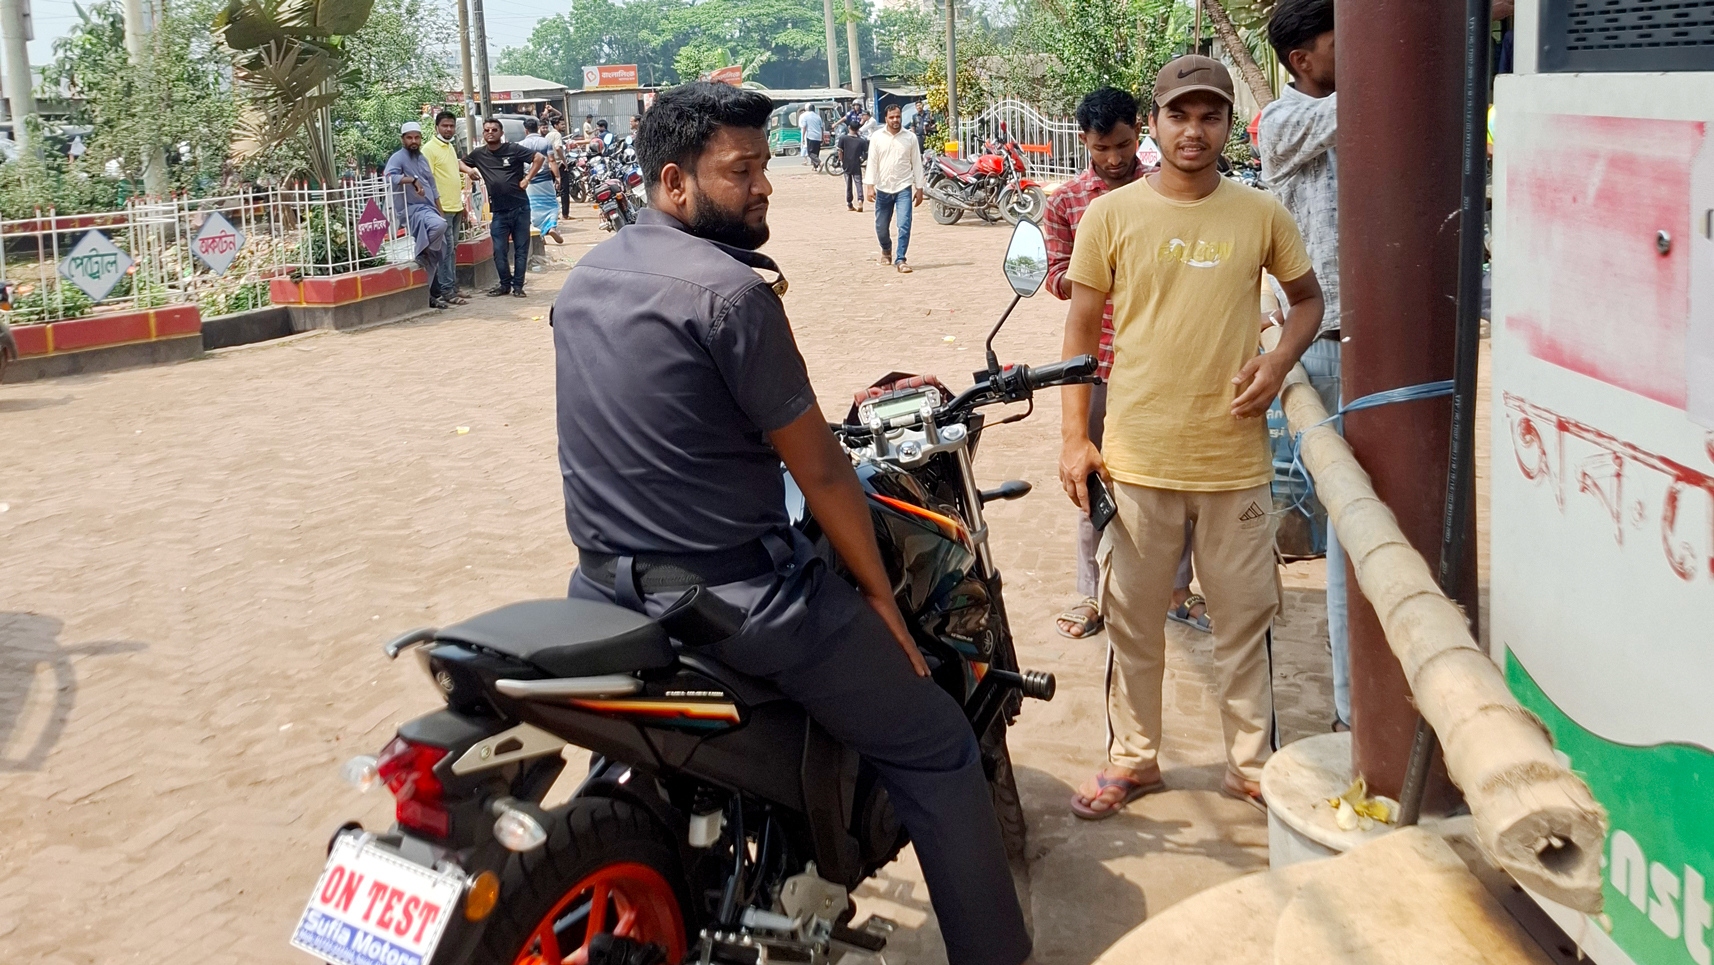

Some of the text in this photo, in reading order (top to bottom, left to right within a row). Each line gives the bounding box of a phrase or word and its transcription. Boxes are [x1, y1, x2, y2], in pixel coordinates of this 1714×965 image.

[198, 230, 237, 255] অকটেন
[68, 248, 119, 281] পেট্রোল
[320, 864, 441, 945] ON TEST
